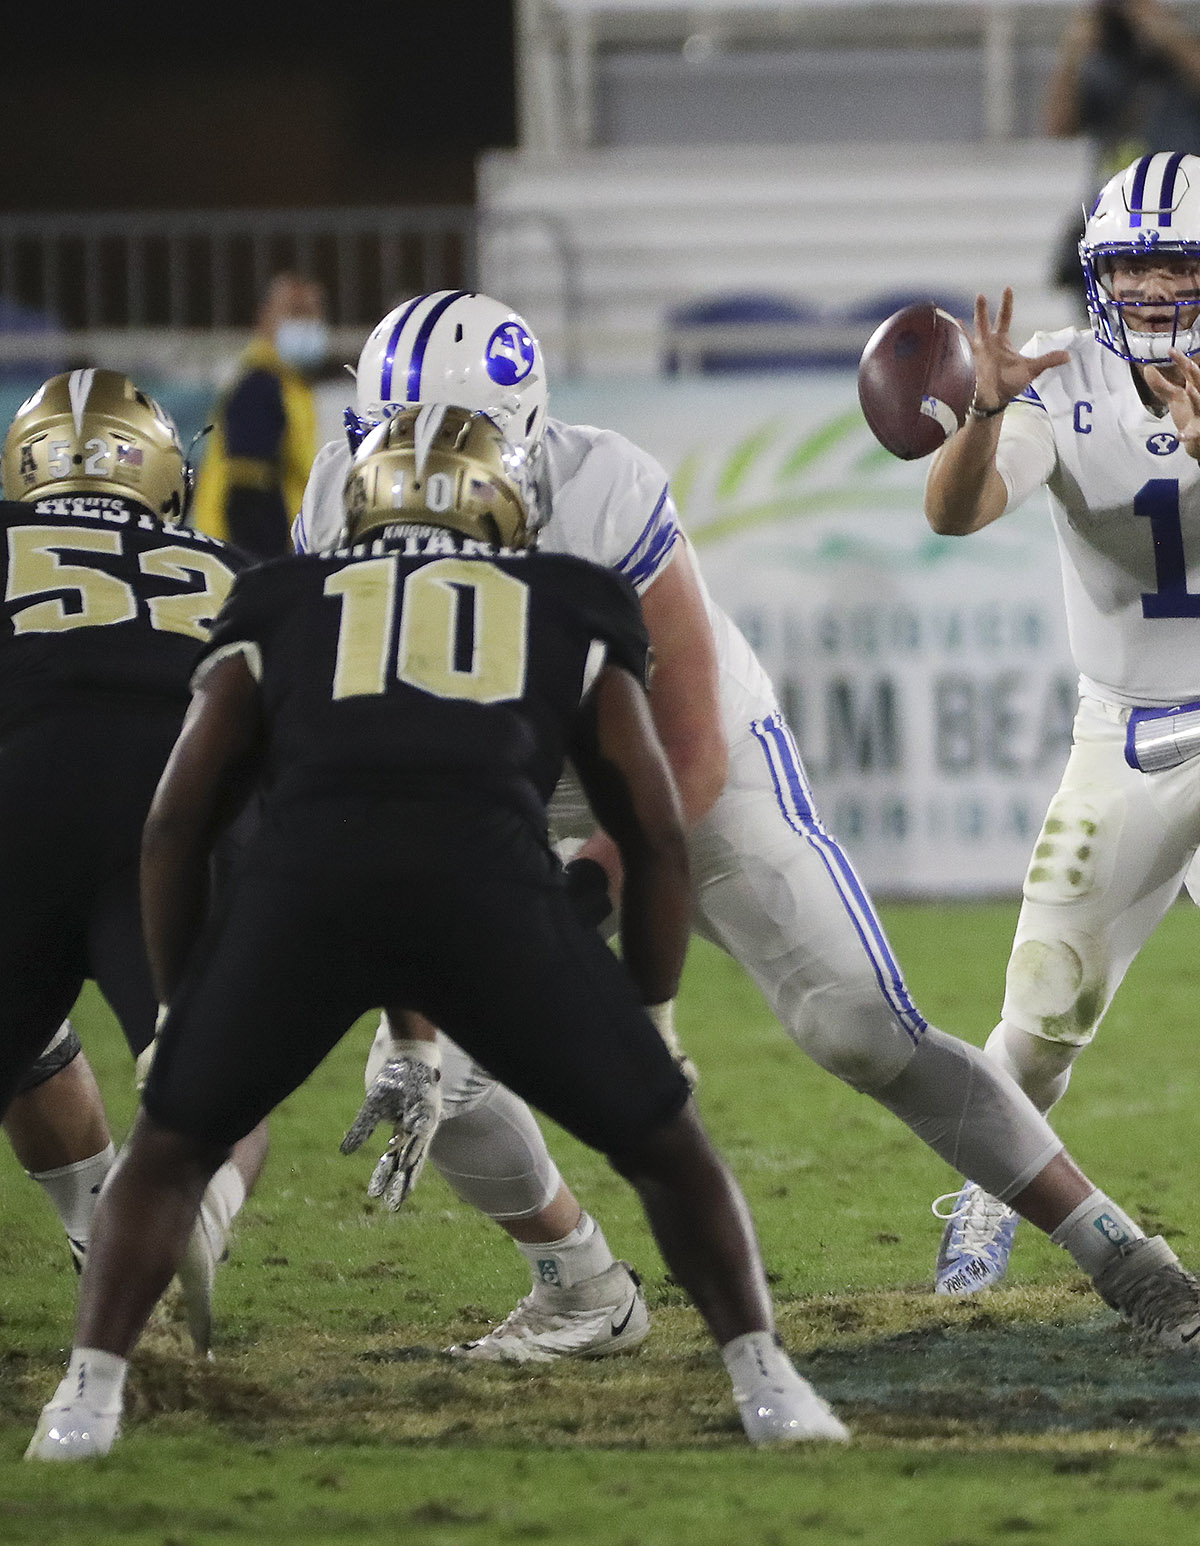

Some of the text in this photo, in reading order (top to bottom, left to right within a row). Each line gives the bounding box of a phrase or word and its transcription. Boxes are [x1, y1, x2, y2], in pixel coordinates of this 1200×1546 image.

[1073, 401, 1092, 434] C
[1149, 434, 1177, 454] Y
[4, 525, 237, 642] 52
[323, 556, 529, 704] 10
